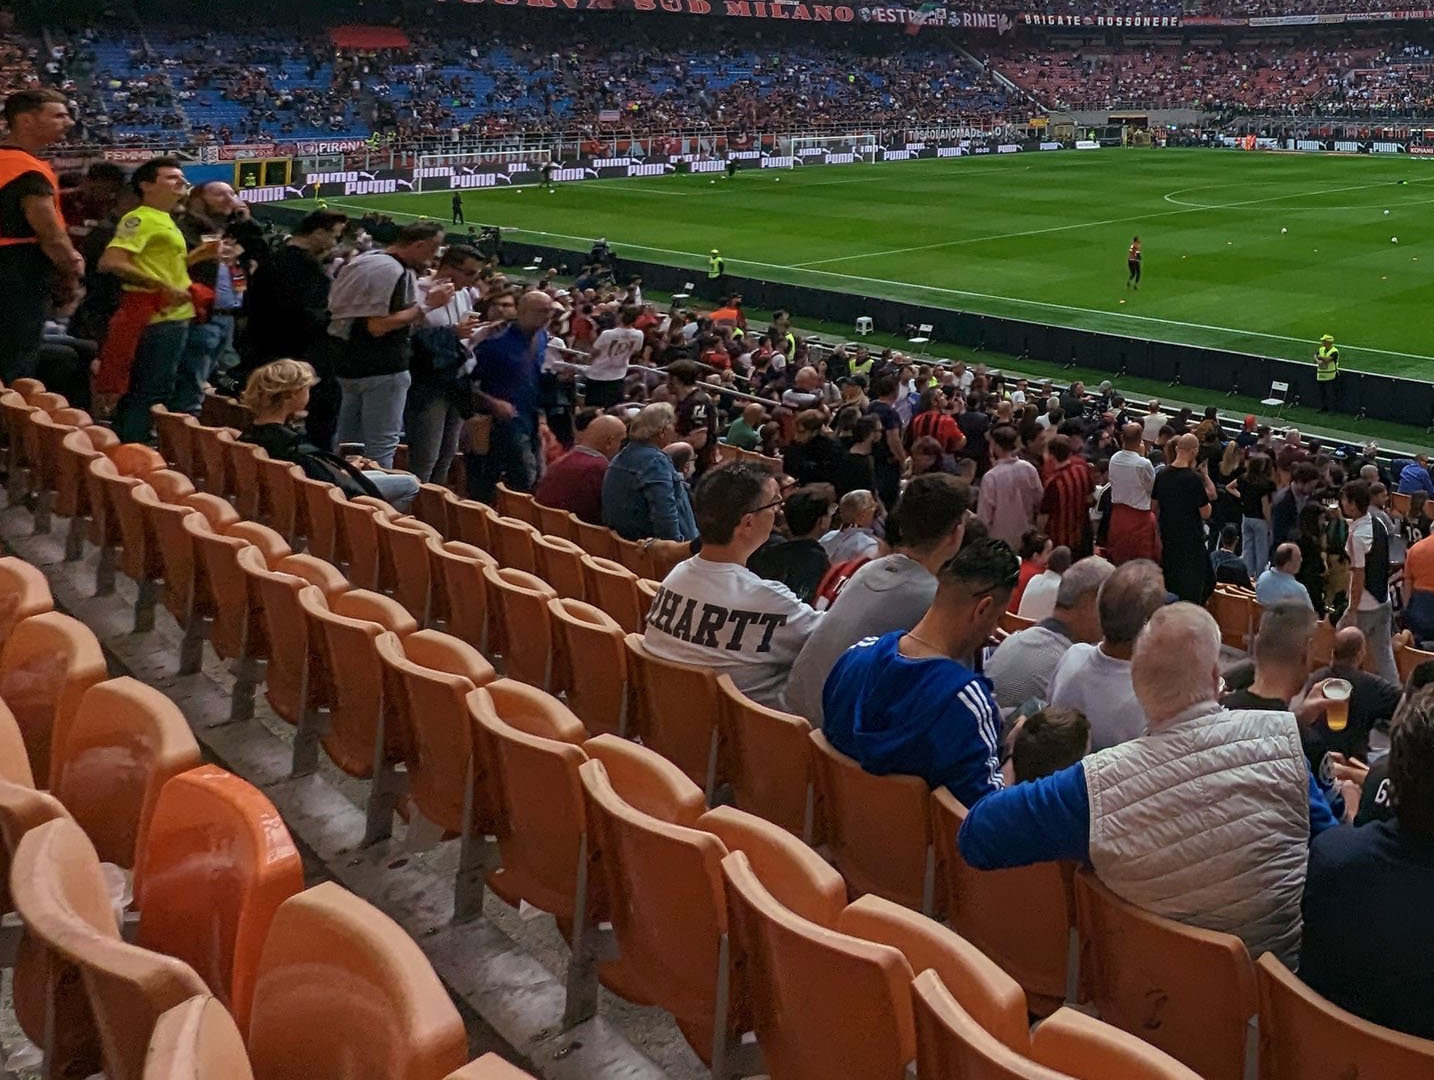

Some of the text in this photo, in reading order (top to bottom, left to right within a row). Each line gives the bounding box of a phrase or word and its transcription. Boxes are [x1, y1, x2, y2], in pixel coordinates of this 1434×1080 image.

[723, 0, 855, 22] MILANO
[1024, 14, 1081, 26] BRIGATE
[1097, 16, 1178, 28] ROSSONERE
[1296, 140, 1319, 150] PUMA
[1334, 141, 1358, 151] PUMA
[1373, 142, 1398, 152] PUMA
[825, 153, 854, 164] PUMA
[883, 150, 910, 161] PUMA
[937, 147, 962, 158] PUMA
[691, 160, 725, 173] PUMA
[761, 156, 793, 168] PUMA
[551, 168, 585, 182] UMA
[627, 163, 665, 176] PUMA
[345, 179, 396, 195] PUMA
[450, 173, 496, 188] PUMA
[239, 187, 285, 203] PUMA
